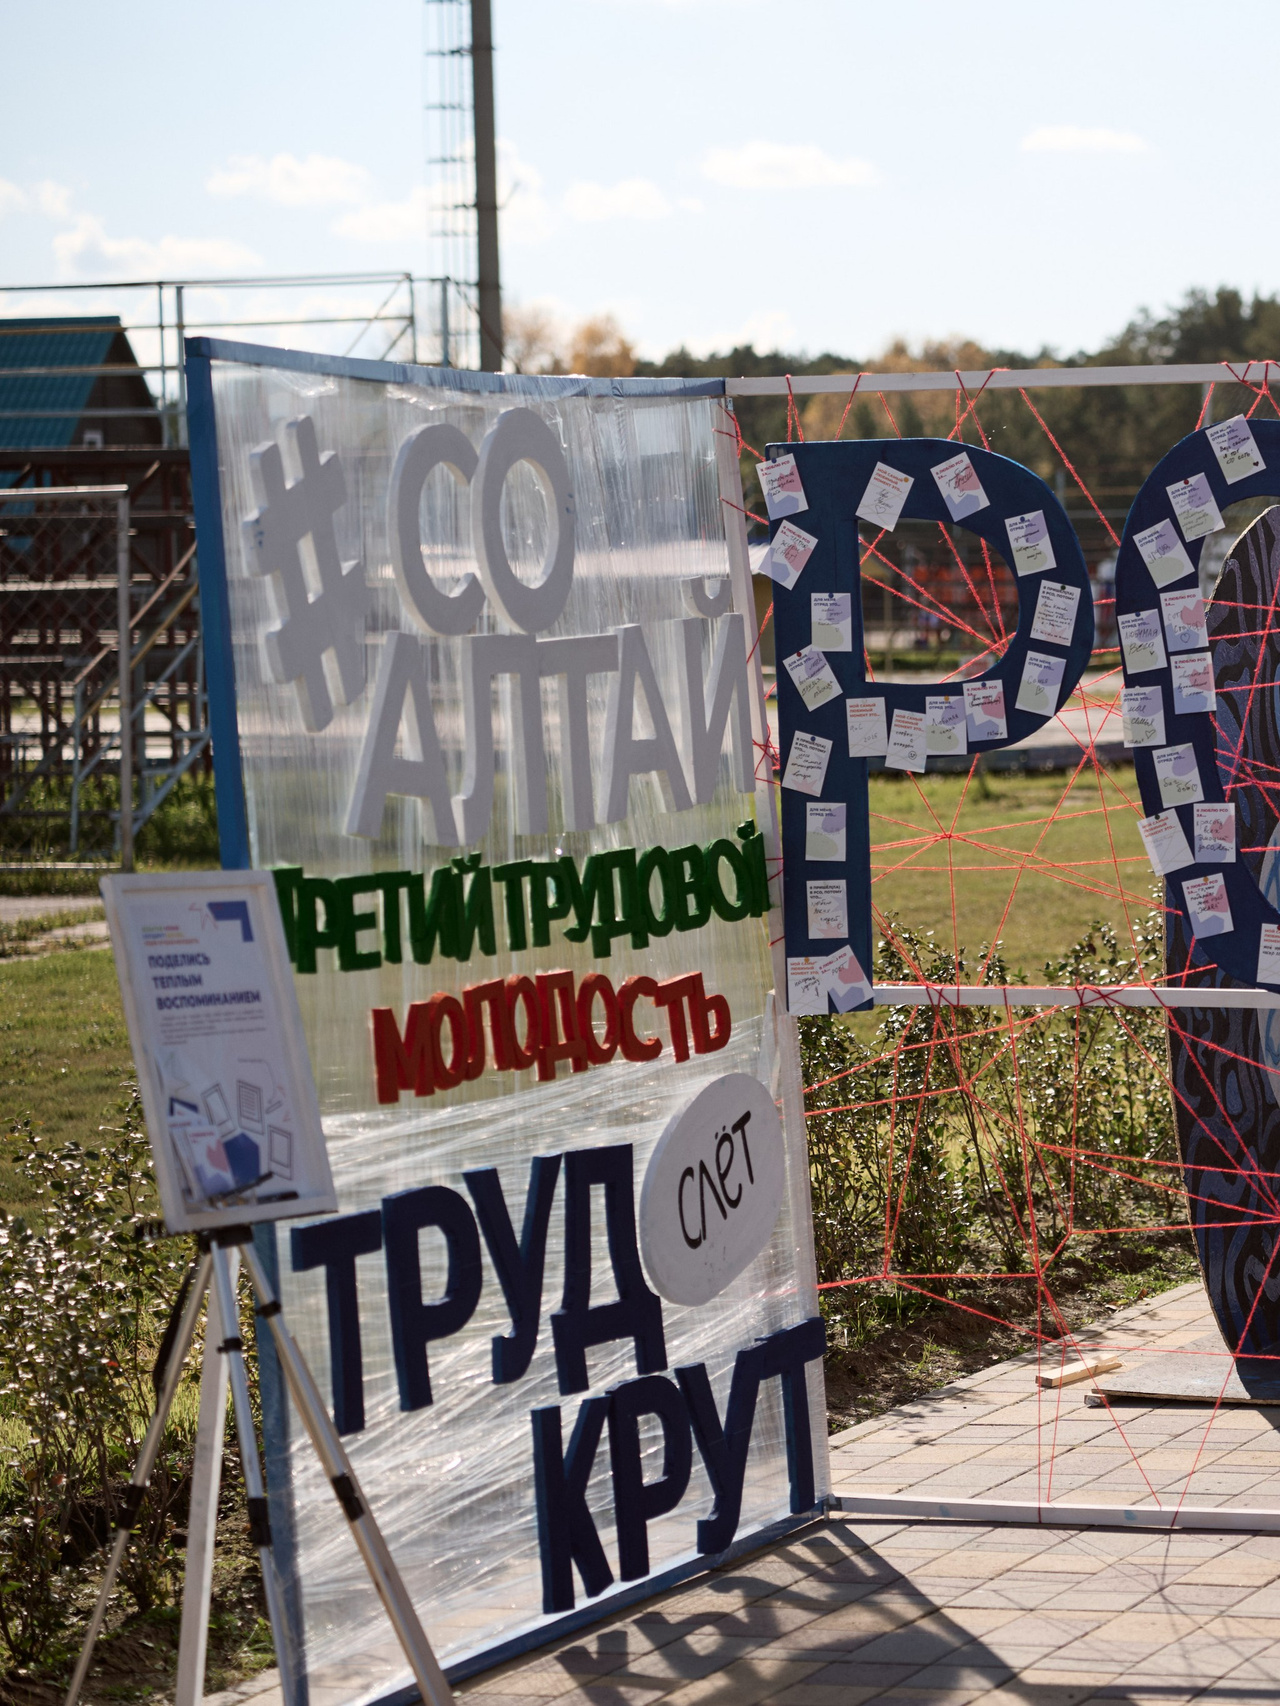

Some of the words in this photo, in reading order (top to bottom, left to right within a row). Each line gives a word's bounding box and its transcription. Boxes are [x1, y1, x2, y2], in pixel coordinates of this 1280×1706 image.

[346, 576, 755, 847] АЛТАЙ
[492, 818, 771, 958] ТРУДОВОЙ
[147, 953, 211, 969] ПОДЕЛИСЬ
[152, 974, 203, 989] ТЕПЛЫМ
[156, 990, 262, 1010] ВОСПОМИНАНИЕМ
[372, 971, 731, 1104] МОЛОДОСТЬ
[292, 1144, 667, 1435] ТРУД
[531, 1317, 825, 1614] КРУТ
